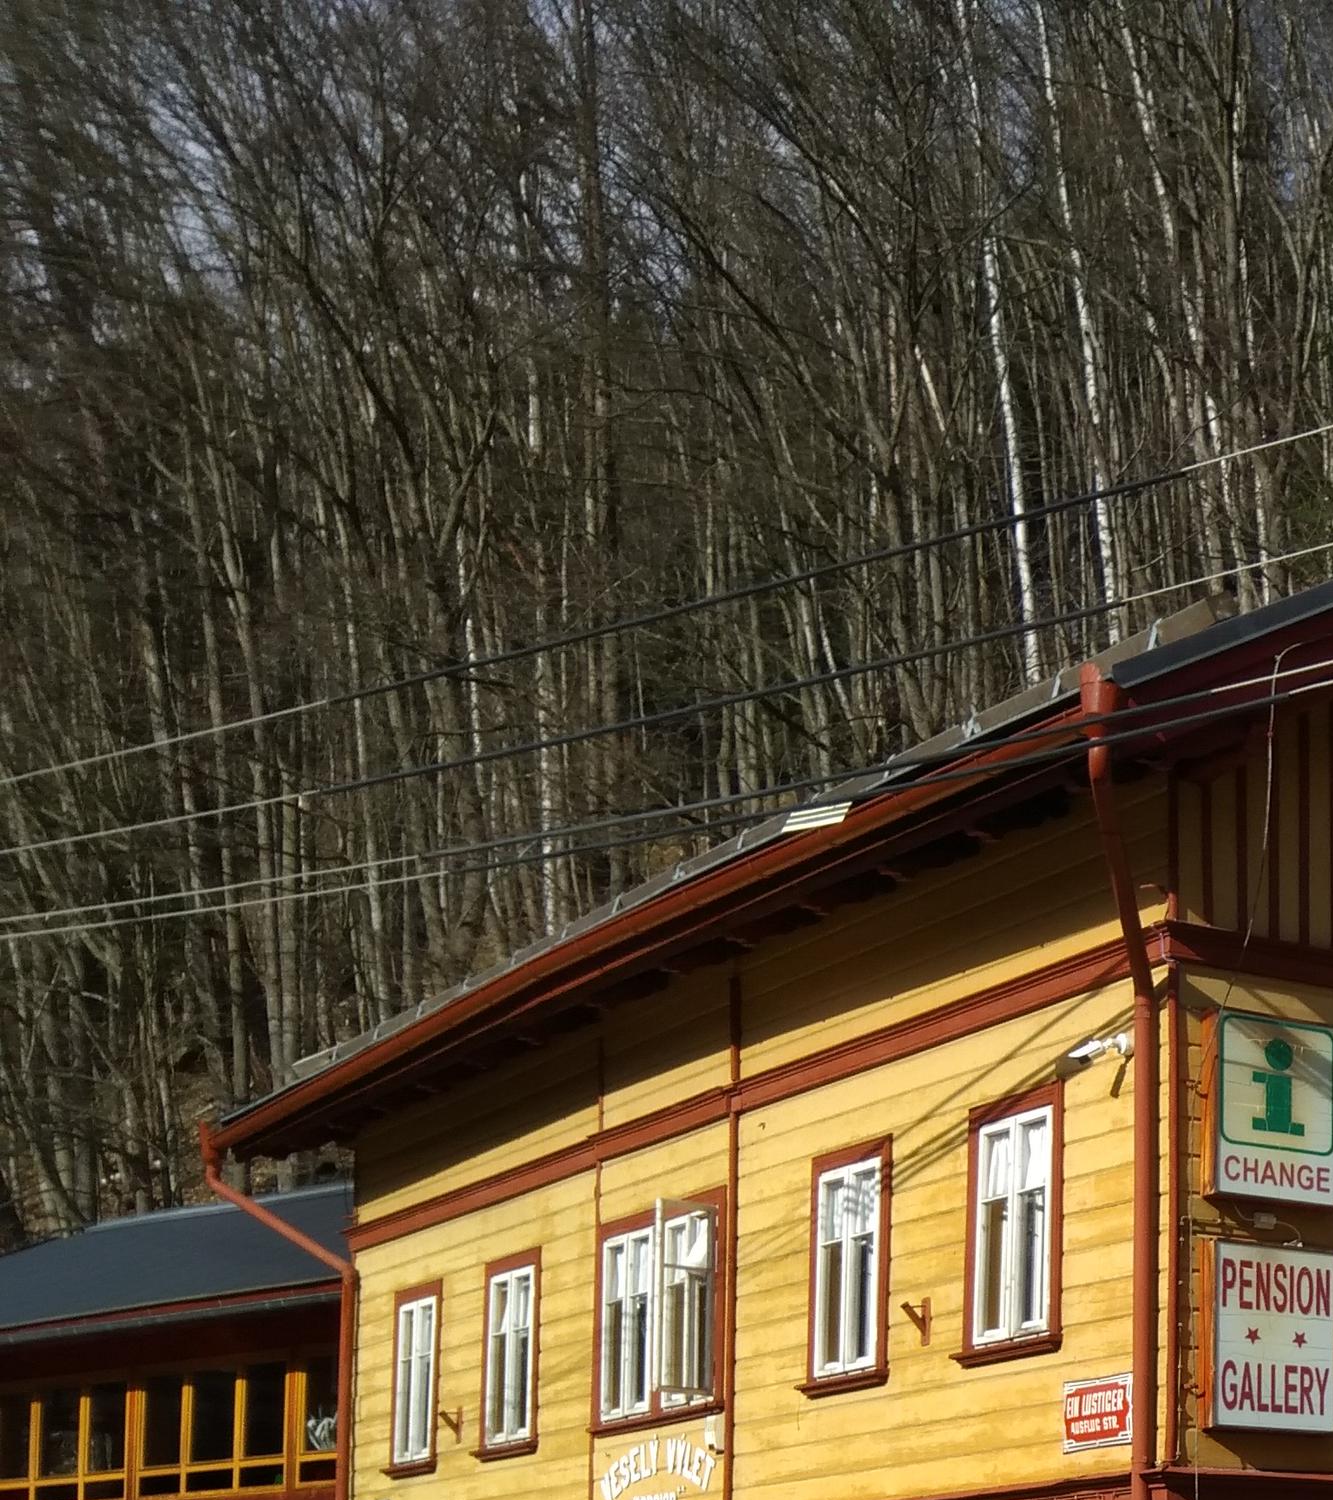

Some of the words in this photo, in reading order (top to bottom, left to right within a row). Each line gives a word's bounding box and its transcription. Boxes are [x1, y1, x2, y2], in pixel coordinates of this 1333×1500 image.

[1224, 1155, 1330, 1193] CHANGE
[1221, 1257, 1331, 1317] PENSION
[1081, 1388, 1125, 1417] LUSTIGER
[1221, 1358, 1330, 1417] GALLERY
[666, 1433, 717, 1491] VÝLET
